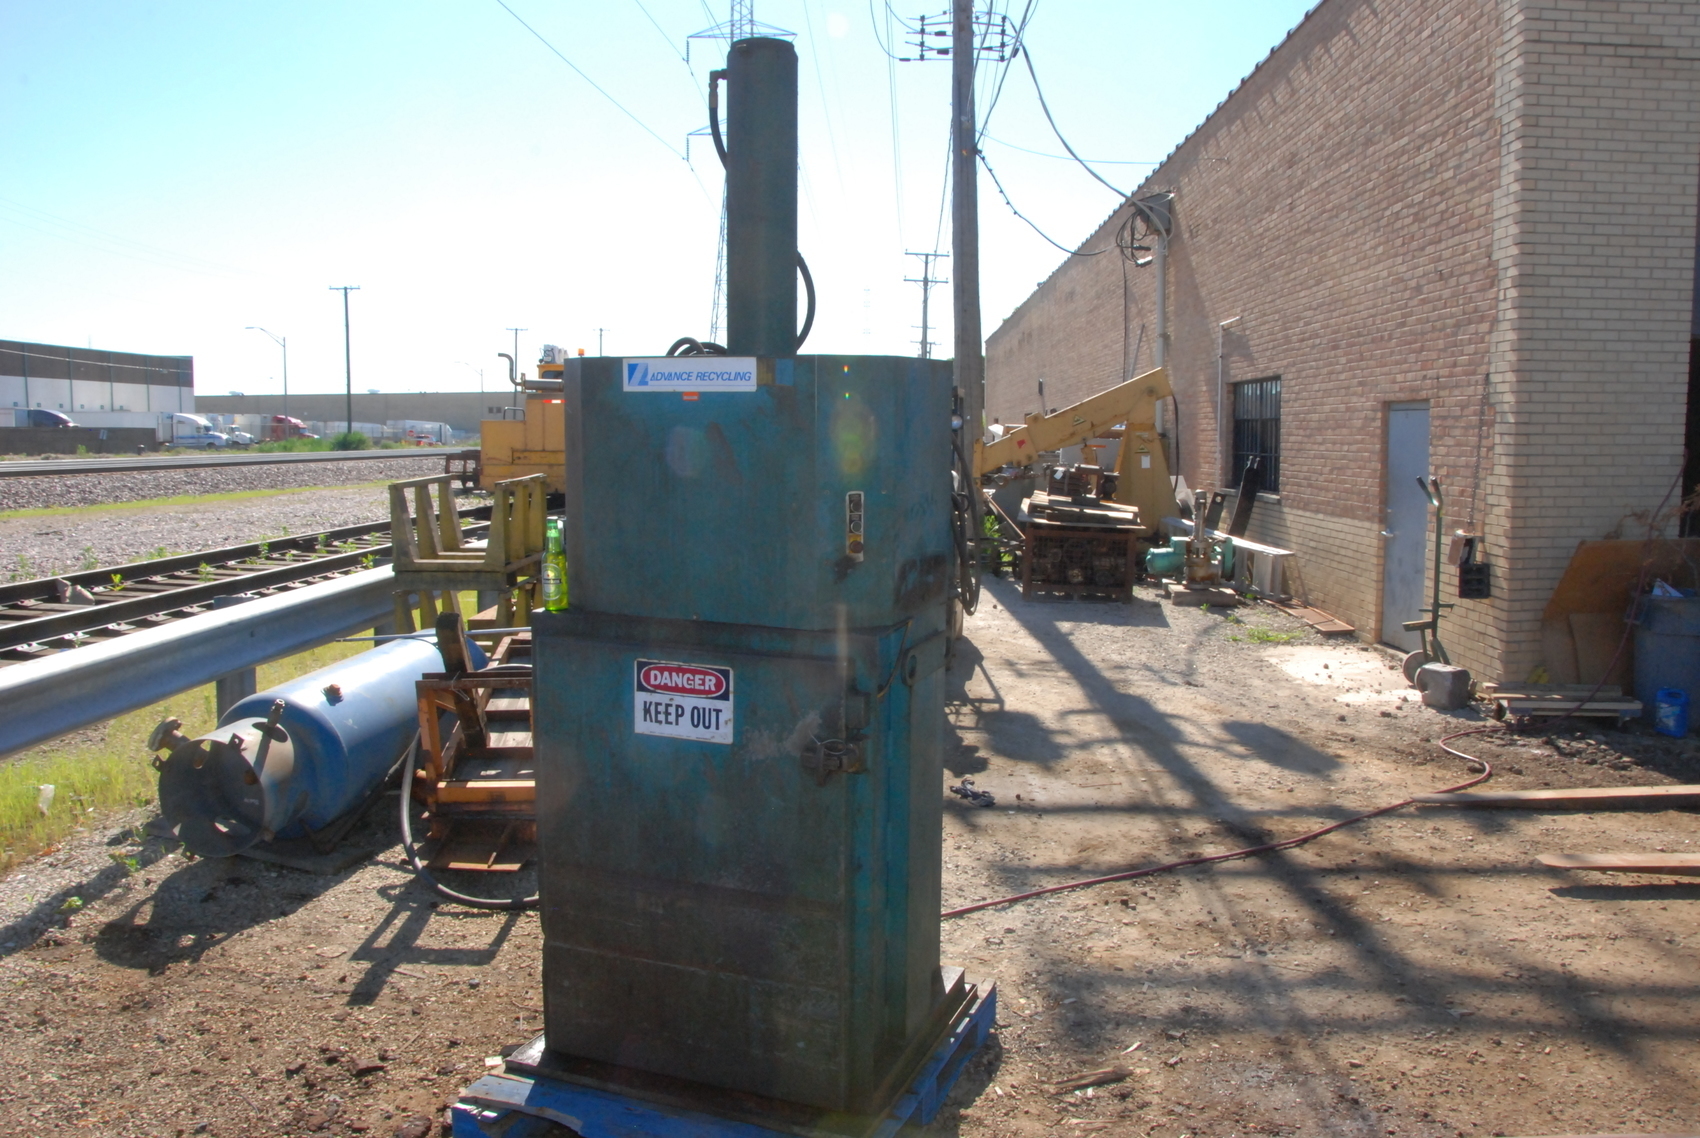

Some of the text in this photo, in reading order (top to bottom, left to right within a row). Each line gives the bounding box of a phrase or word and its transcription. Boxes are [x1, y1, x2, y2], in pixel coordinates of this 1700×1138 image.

[650, 372, 752, 381] ADVANCE RECYCLING
[650, 670, 716, 691] DANGER
[643, 700, 722, 731] KEEP OUT
